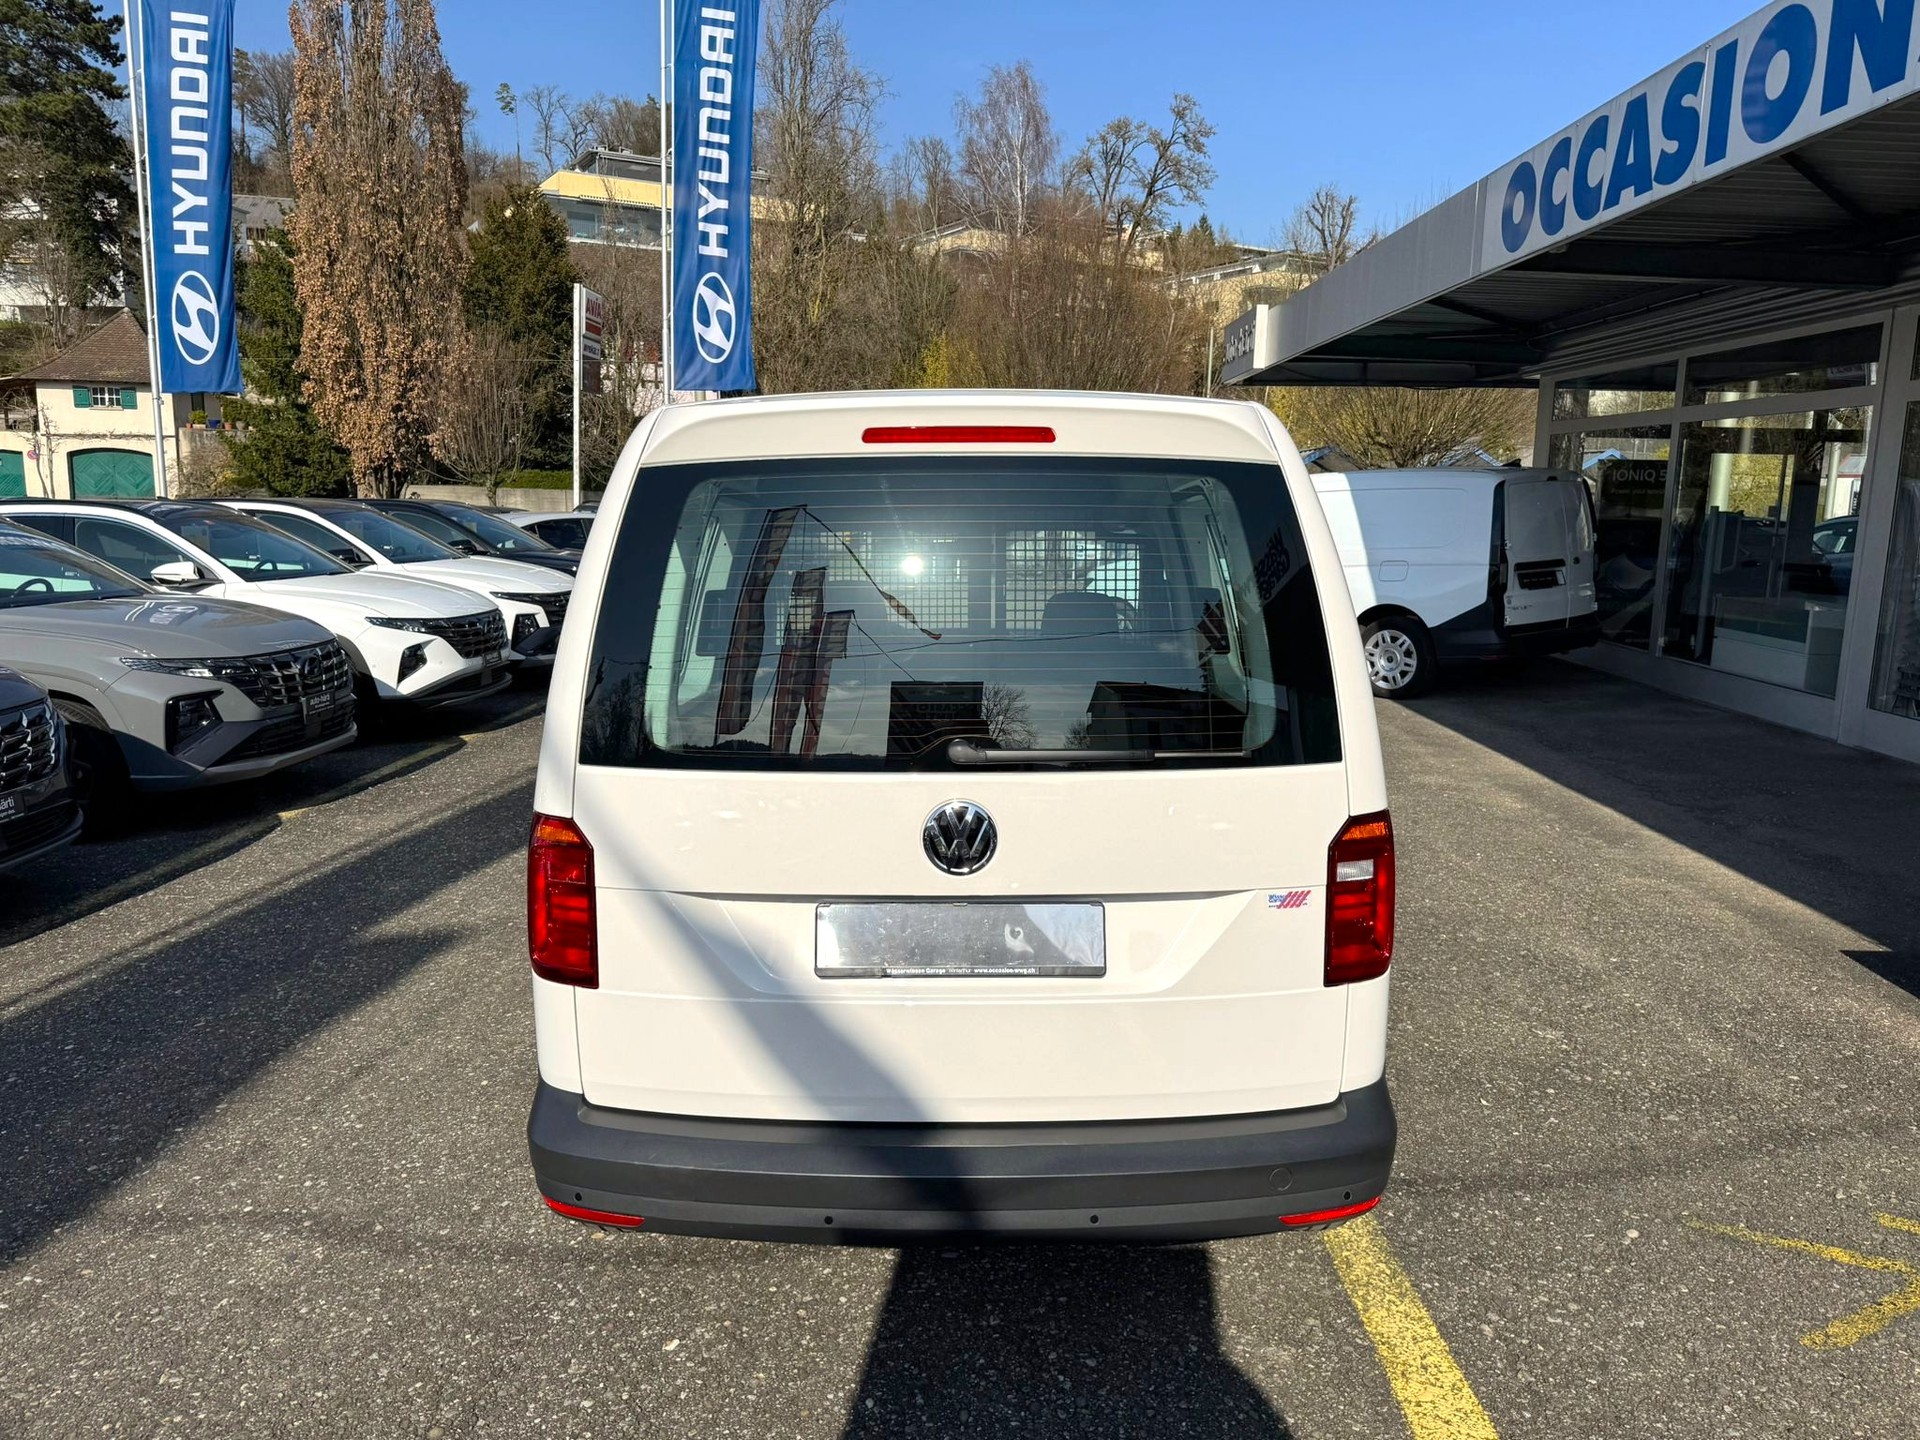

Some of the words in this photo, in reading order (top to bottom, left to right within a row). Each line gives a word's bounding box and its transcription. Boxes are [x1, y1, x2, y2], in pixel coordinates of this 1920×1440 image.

[171, 11, 209, 255] HYUNDAI
[698, 7, 736, 258] HYUNDAI
[1501, 0, 1920, 253] OCCASION
[1613, 469, 1656, 483] IONIQ
[0, 796, 14, 810] ärti
